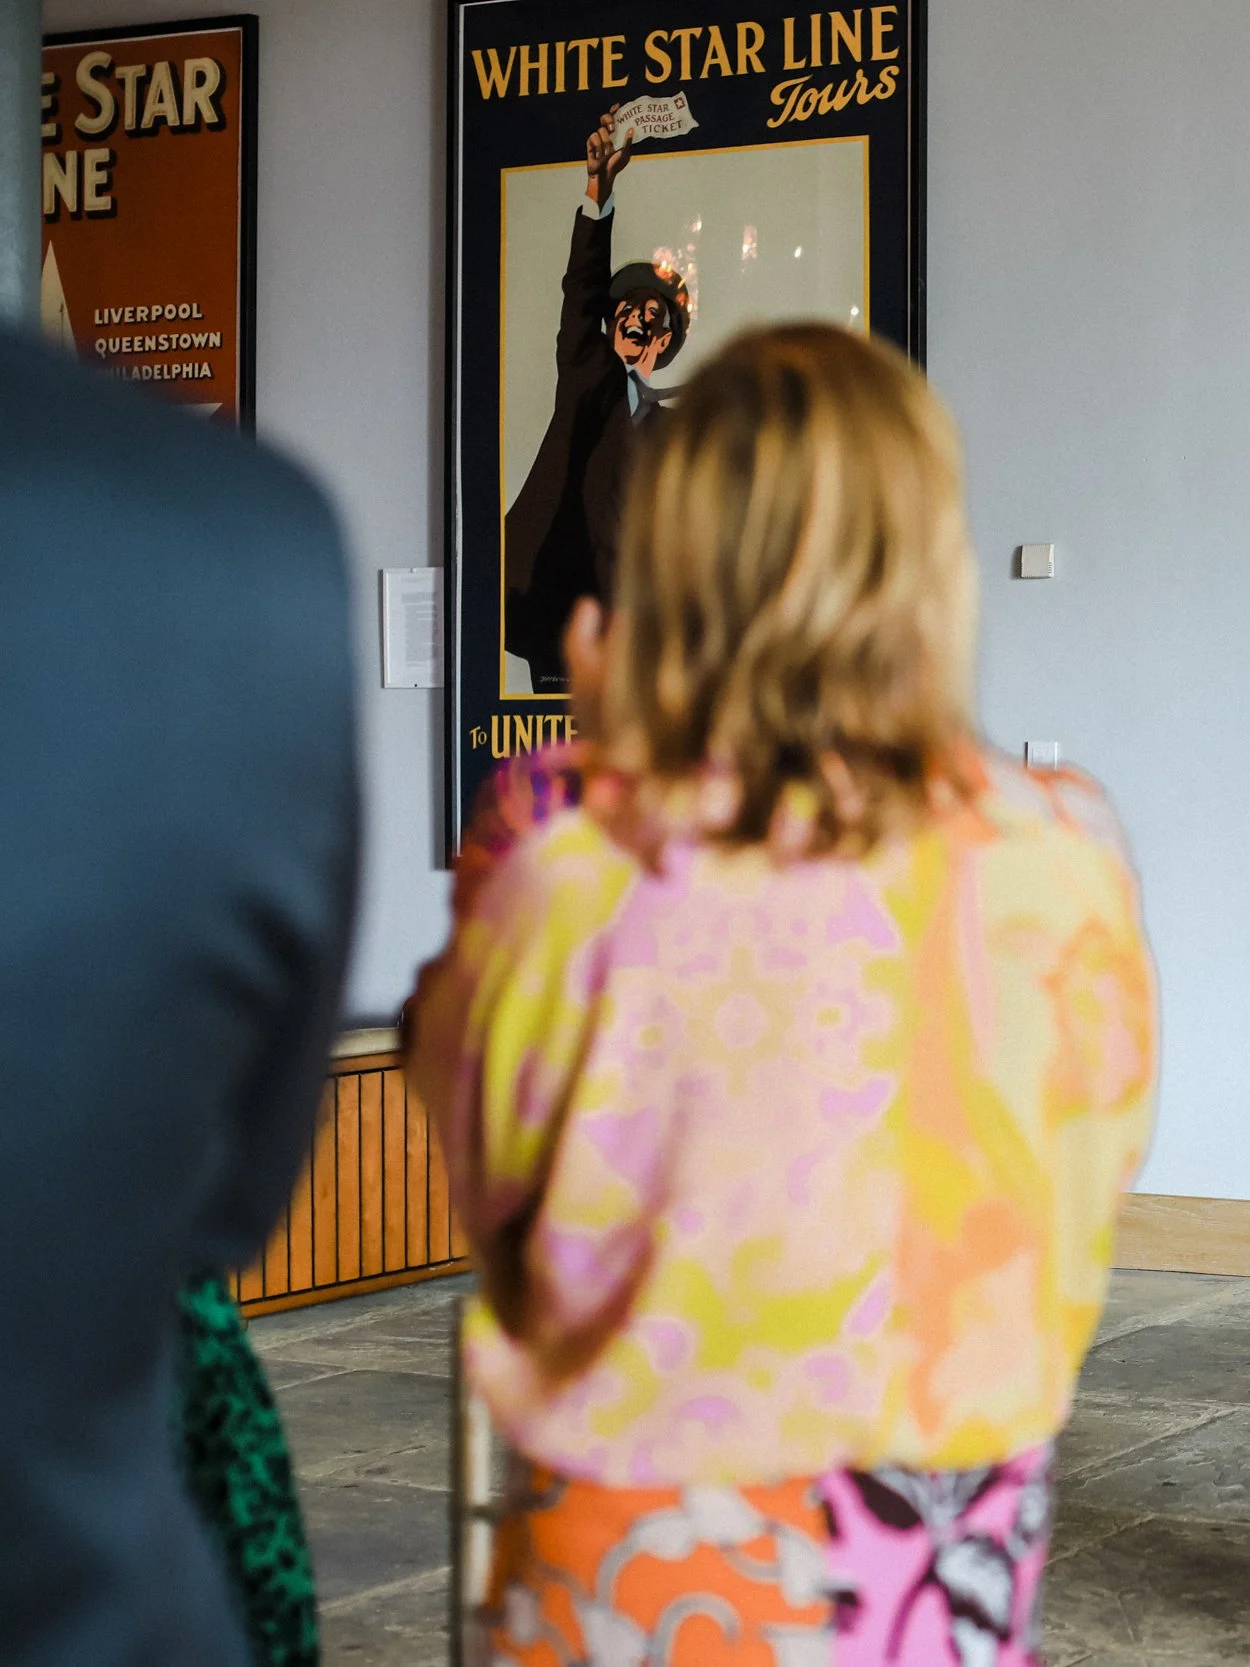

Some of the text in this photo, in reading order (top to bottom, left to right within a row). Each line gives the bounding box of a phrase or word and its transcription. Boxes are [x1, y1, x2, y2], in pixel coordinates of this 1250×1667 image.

[471, 4, 900, 100] WHITE STAR LINE
[75, 51, 221, 135] STAR
[766, 65, 901, 129] Tours
[617, 103, 670, 124] WHITE STAR
[634, 112, 676, 126] PASSAGE
[642, 120, 682, 133] TICKET
[43, 148, 112, 214] NE
[94, 303, 203, 324] LIVERPOOL
[95, 331, 222, 359] QUEENSTOWN
[101, 362, 212, 381] HILADELPHIA
[469, 725, 488, 750] To
[491, 714, 579, 759] UNITE
